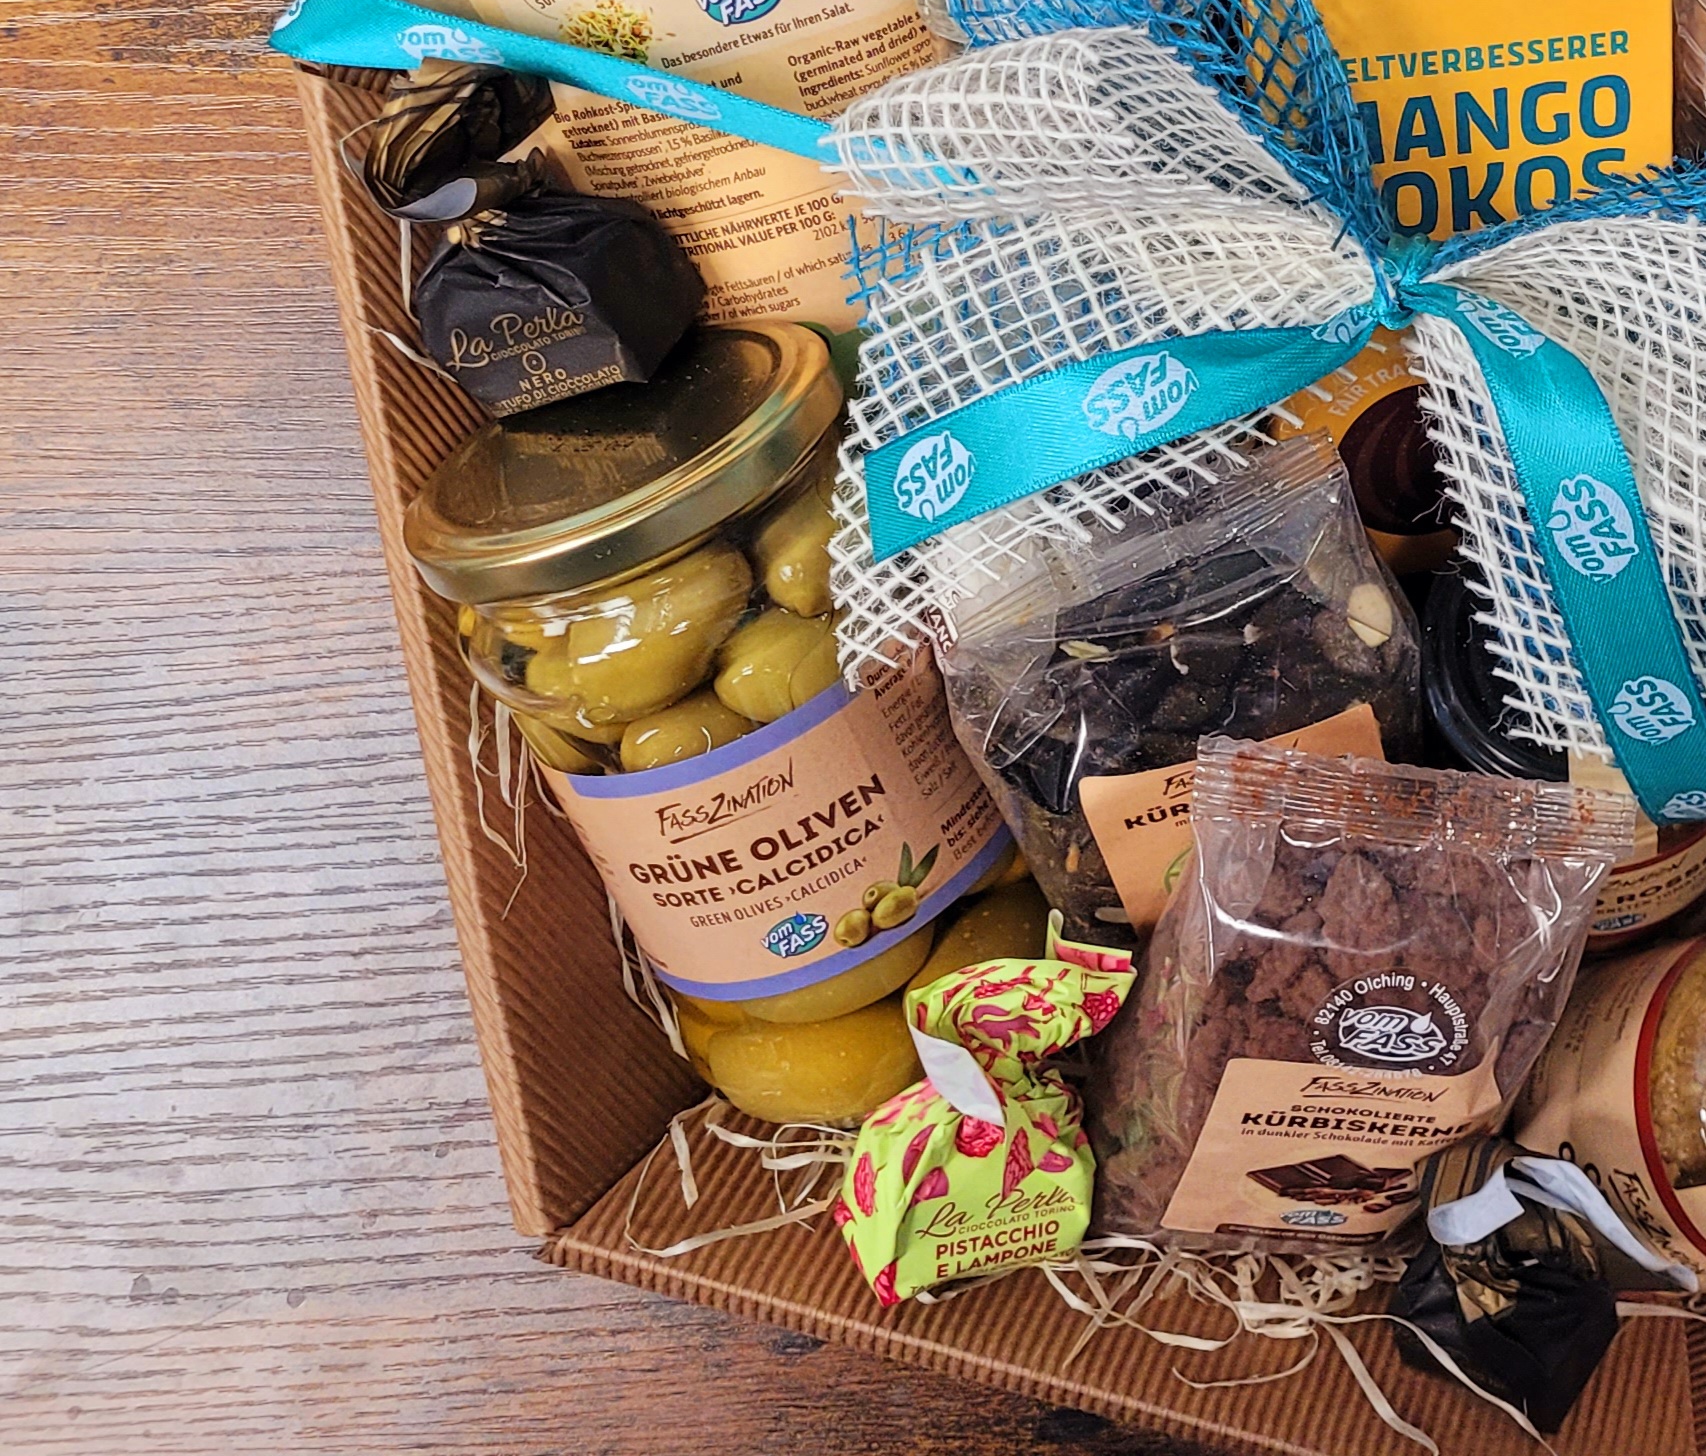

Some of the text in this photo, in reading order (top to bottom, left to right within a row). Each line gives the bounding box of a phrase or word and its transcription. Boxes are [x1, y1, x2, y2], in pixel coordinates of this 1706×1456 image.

[660, 2, 855, 70] Das besondere Etwas für Ihren Salat.
[787, 15, 913, 67] Organic-Raw vegetable
[793, 27, 918, 83] (germinated and dried)
[798, 48, 915, 98] Ingredients: Sunflower
[1343, 31, 1629, 83] ELTVERBESSERER
[1382, 148, 1625, 236] OKOS
[490, 307, 585, 345] Perla
[491, 336, 551, 361] CIOCCOLATO
[519, 368, 568, 392] NERO
[548, 365, 621, 394] CIOCCOLATO
[629, 773, 888, 885] GRÜNE OLIVEN
[653, 887, 725, 909] SORTE
[689, 906, 733, 929] GREEN
[733, 895, 785, 924] OLIVES
[760, 924, 794, 950] vom
[778, 914, 829, 959] FASS
[1315, 990, 1353, 1025] 82140
[1354, 972, 1415, 994] Olching
[1439, 1050, 1457, 1066] 47
[1339, 1008, 1408, 1033] vom
[1340, 1028, 1447, 1055] FASS
[1290, 1104, 1437, 1125] SCHOKOLIERTE
[1240, 1127, 1414, 1147] in dunkler Schokolade mit
[958, 1203, 1076, 1235] CIOCCOLATO TORINO
[985, 1185, 1084, 1219] Perla
[935, 1219, 1061, 1260] PISTACCHIO
[936, 1239, 1058, 1278] E LAMPONE
